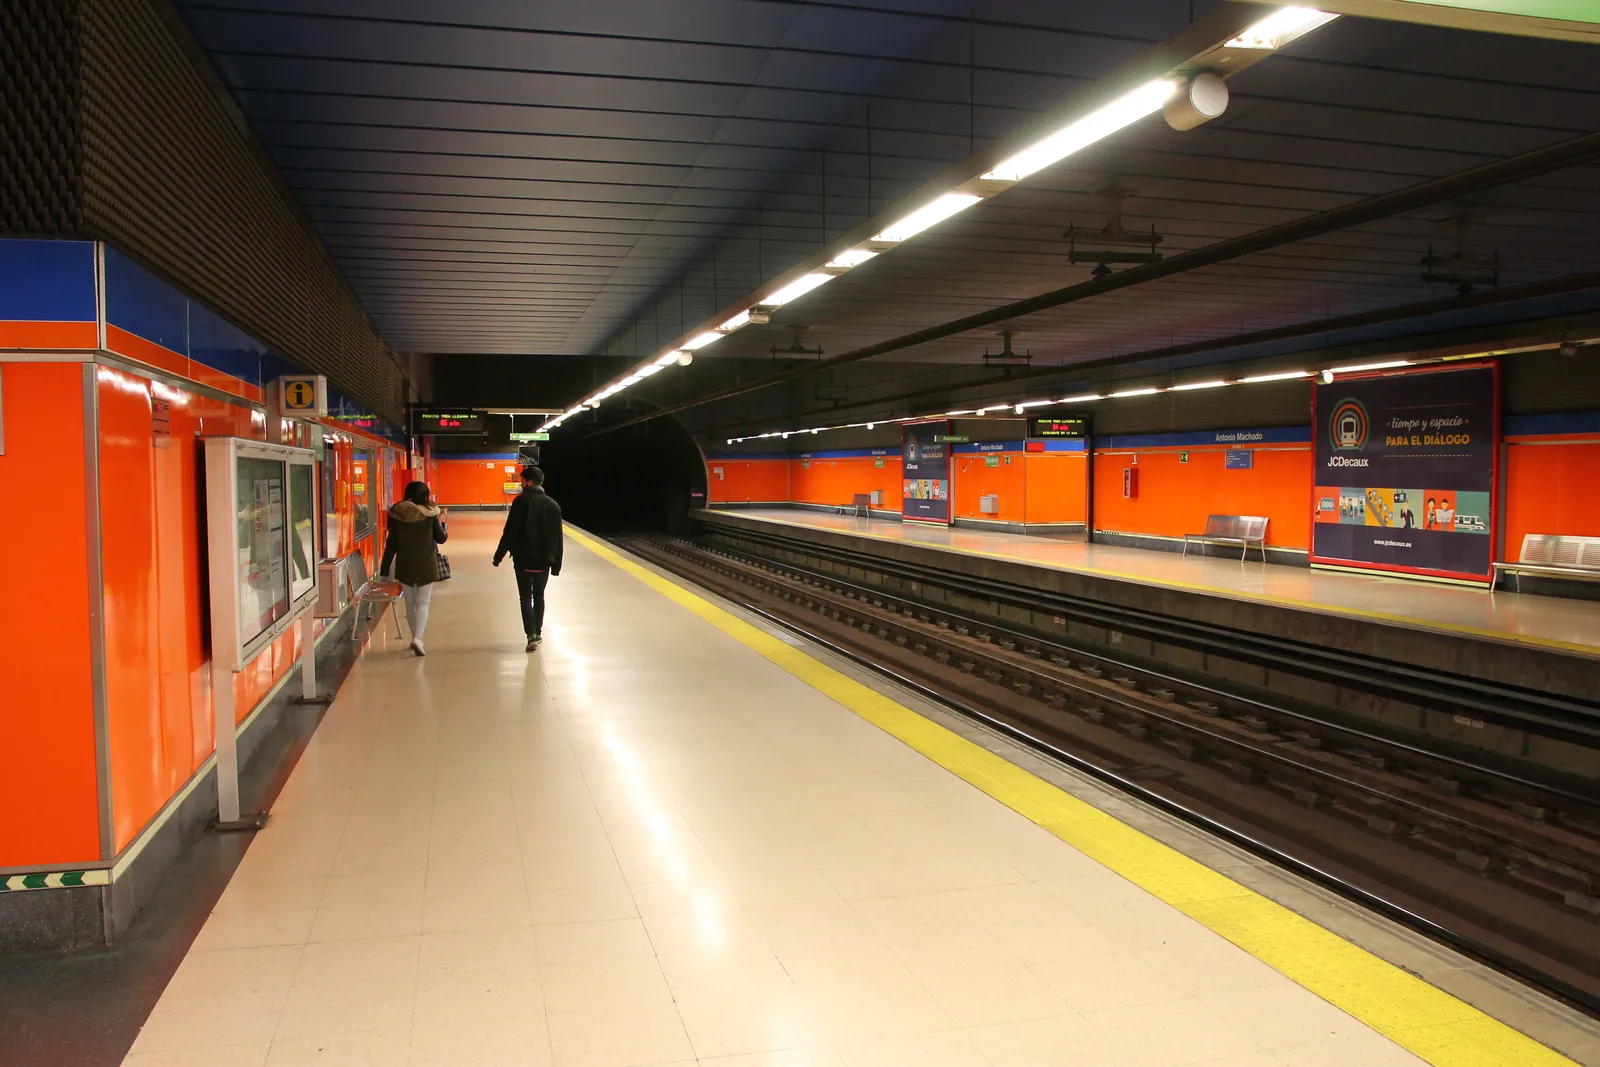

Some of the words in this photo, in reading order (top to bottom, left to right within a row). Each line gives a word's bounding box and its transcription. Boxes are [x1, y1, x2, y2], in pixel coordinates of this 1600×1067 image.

[1391, 417, 1420, 432] tiempo
[1421, 420, 1428, 431] y
[1429, 415, 1463, 430] espacio
[1215, 433, 1236, 442] Antonio
[1236, 432, 1263, 441] Machado
[1386, 435, 1409, 446] PARA
[1411, 435, 1422, 446] EL
[1423, 432, 1470, 446] DIÁLOGO
[1327, 456, 1369, 468] JCDecaux
[1373, 539, 1412, 548] www.jcdecaux.es
